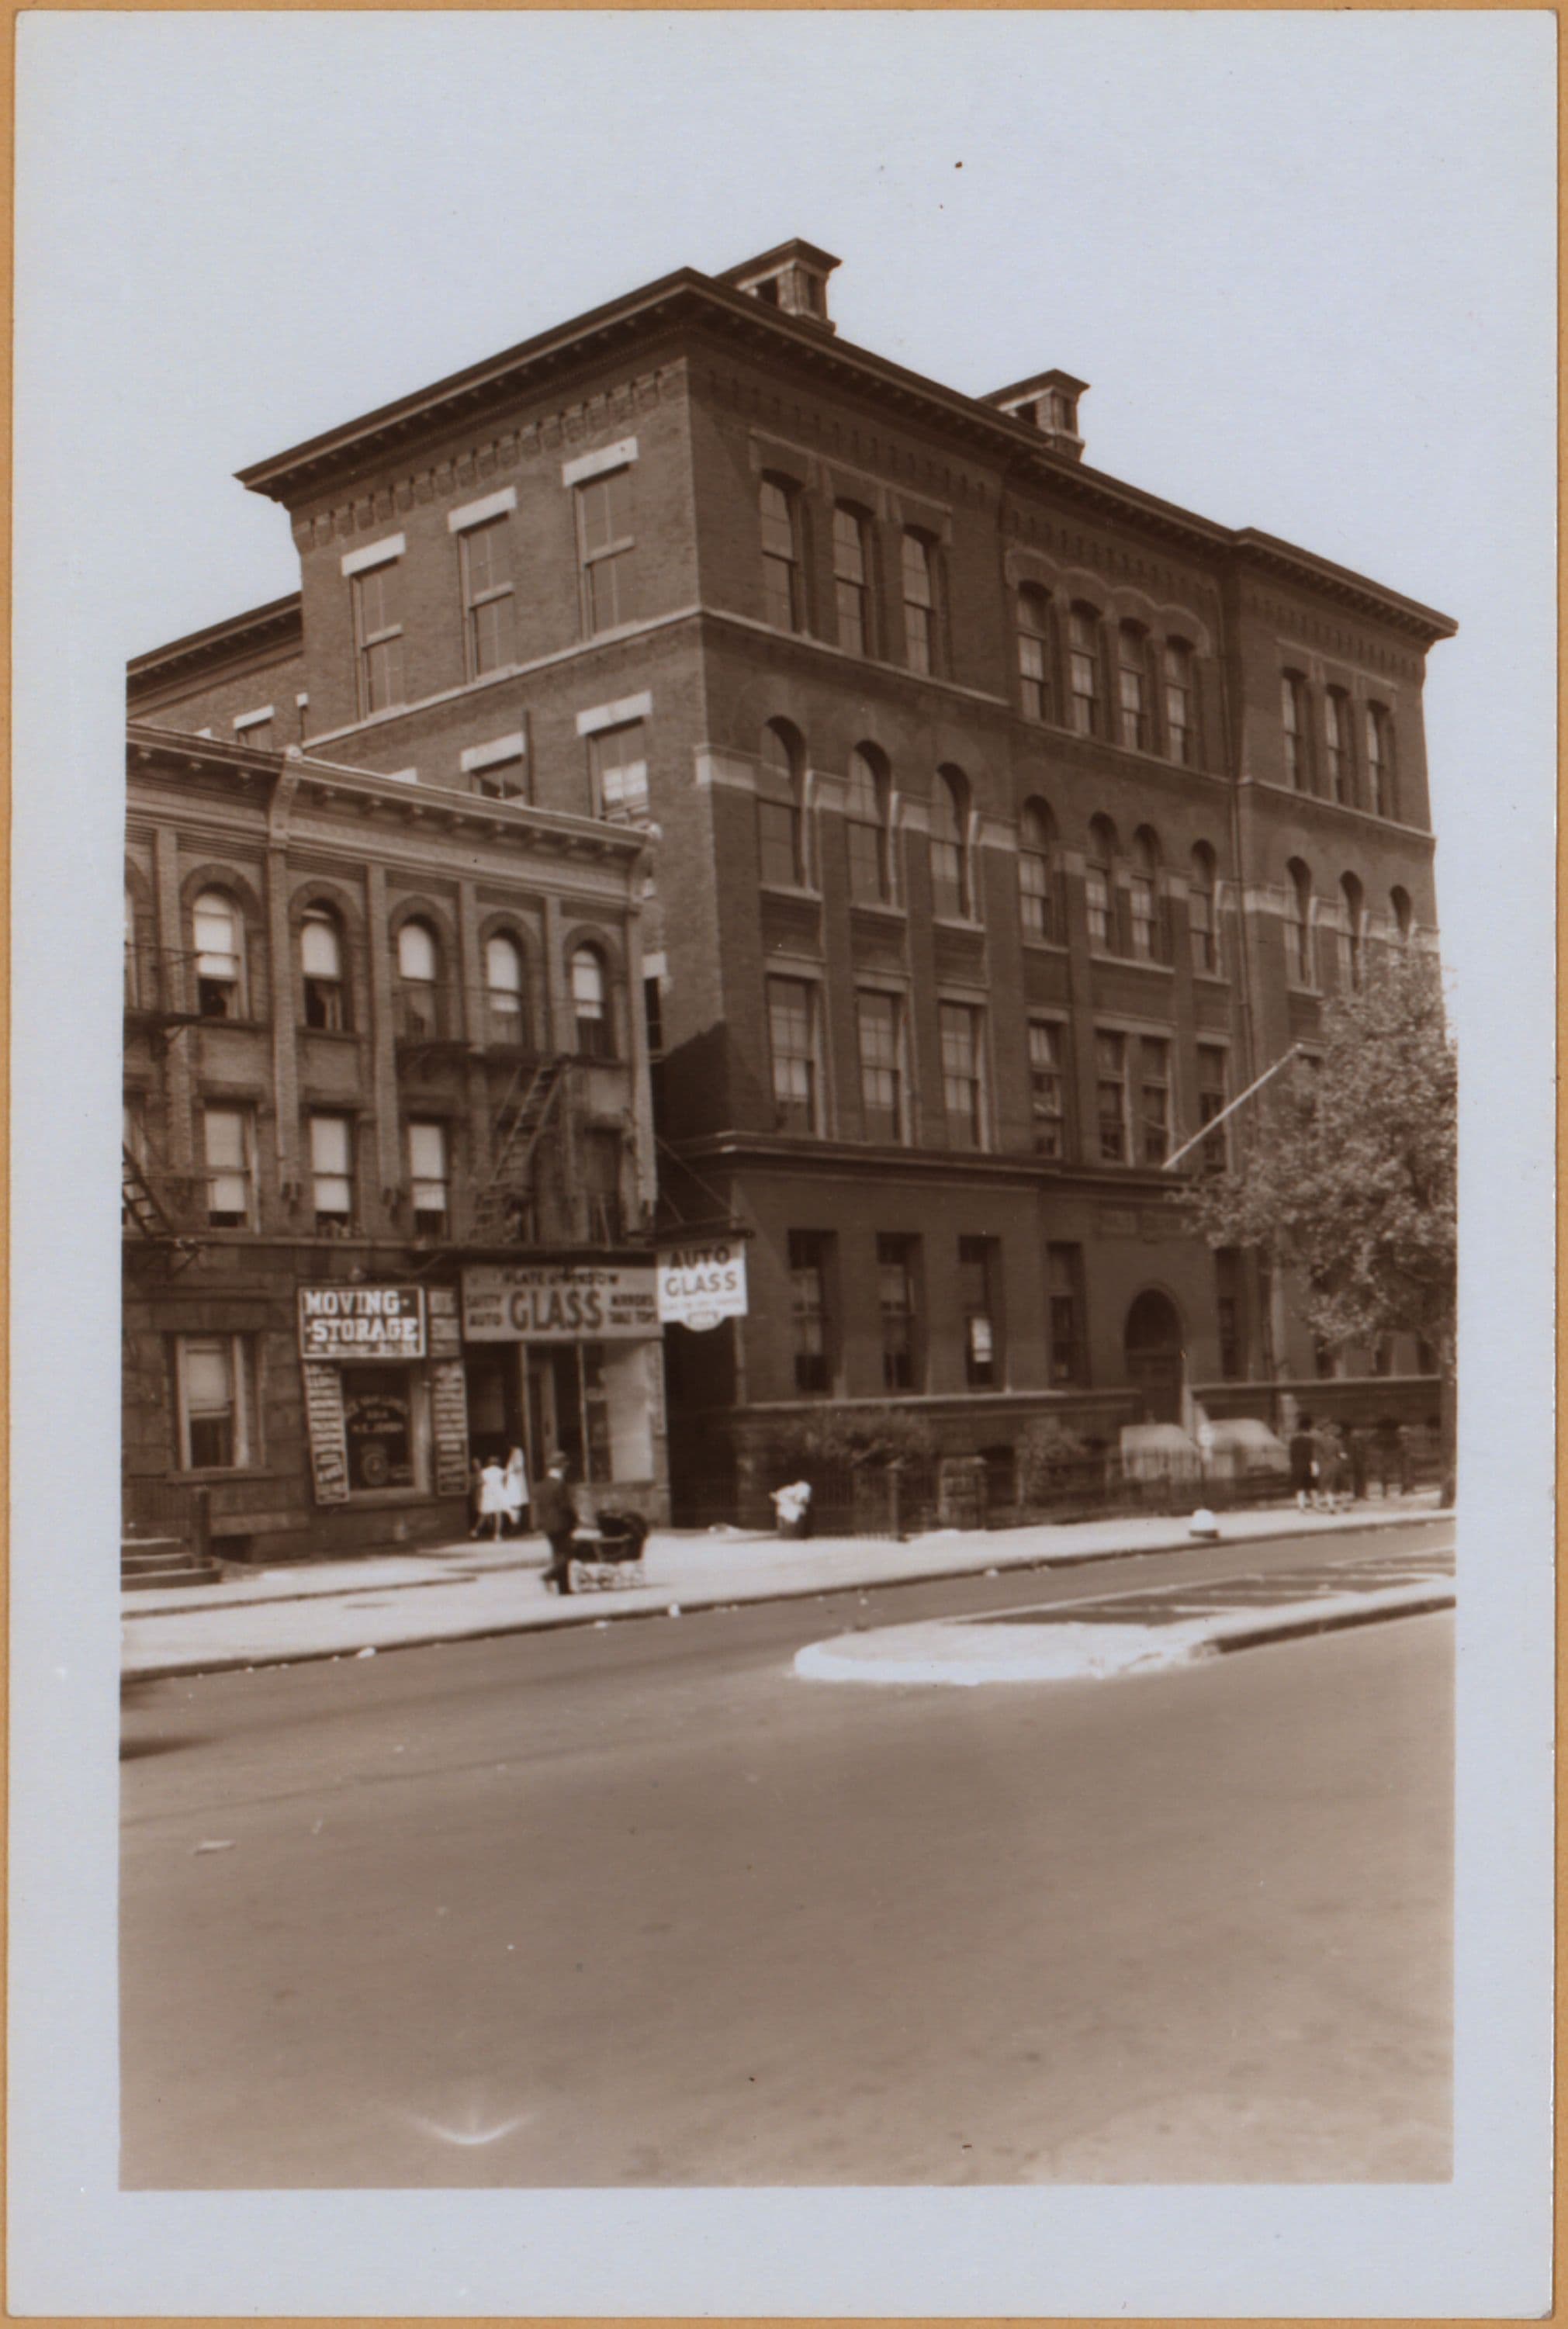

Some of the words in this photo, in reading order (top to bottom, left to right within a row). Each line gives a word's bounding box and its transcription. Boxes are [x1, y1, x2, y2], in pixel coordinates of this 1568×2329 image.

[670, 1245, 730, 1269] AUTO
[664, 1270, 738, 1298] GLASS
[303, 1290, 400, 1316] MOVING
[509, 1290, 604, 1332] GLASS
[311, 1317, 418, 1342] STORAGE
[469, 1312, 503, 1327] AUTO
